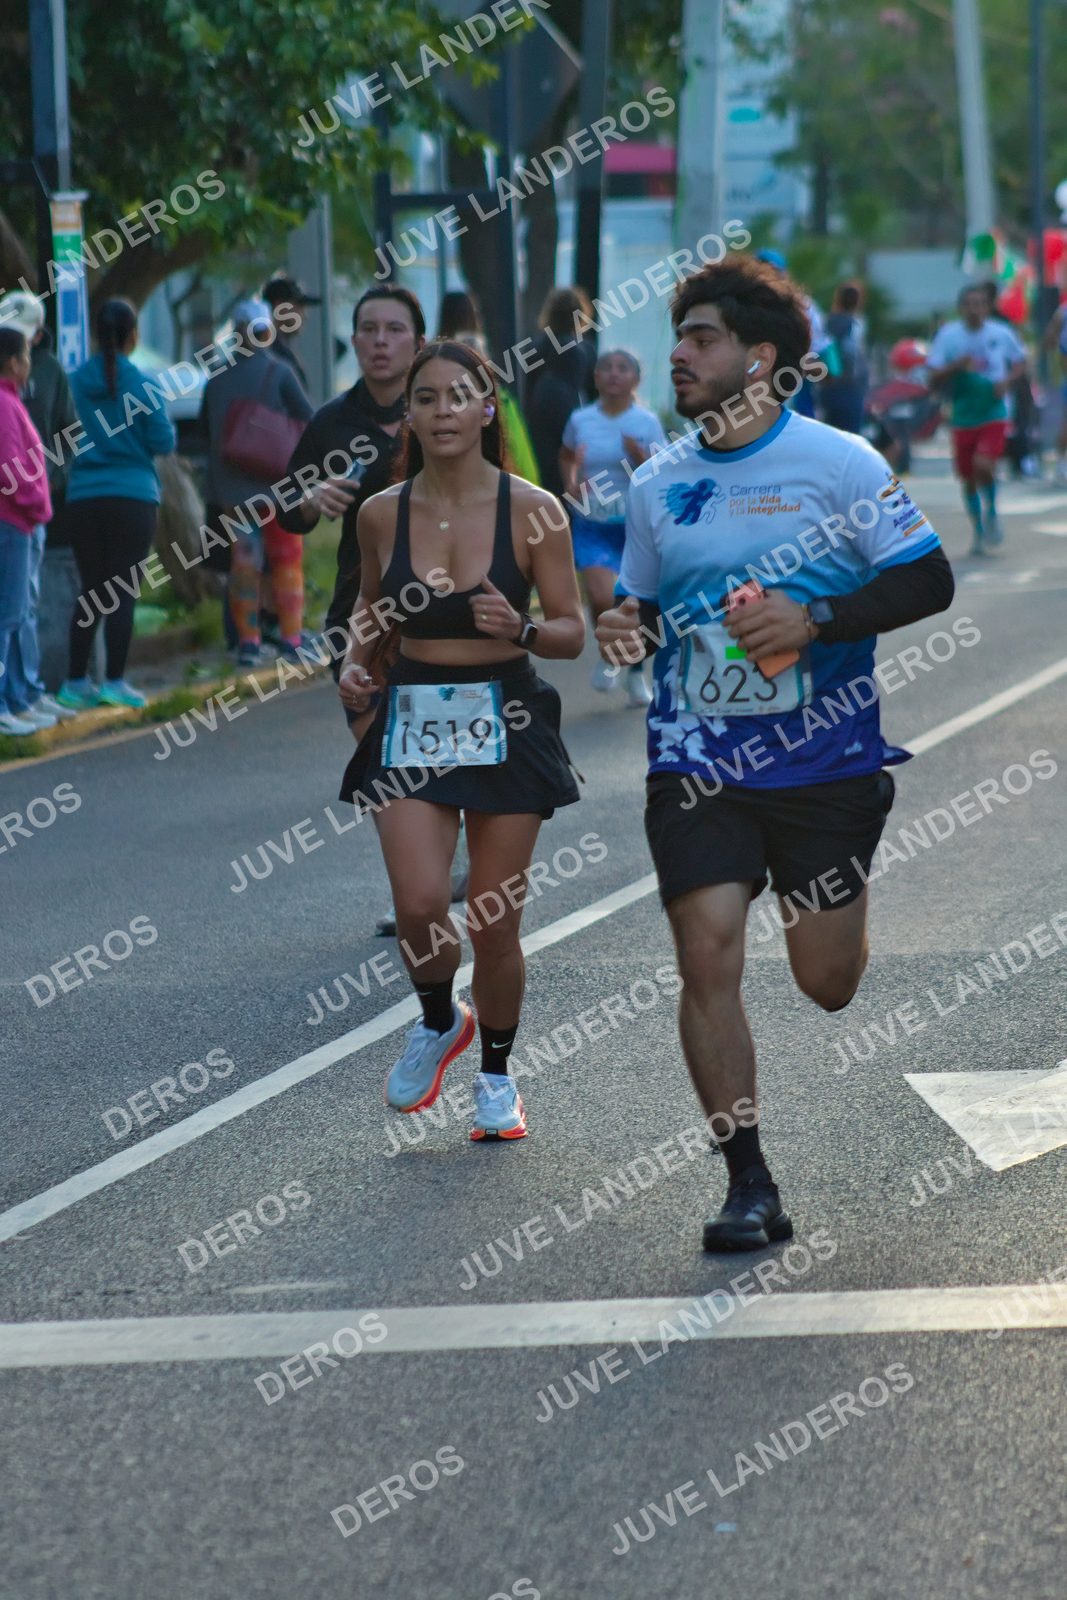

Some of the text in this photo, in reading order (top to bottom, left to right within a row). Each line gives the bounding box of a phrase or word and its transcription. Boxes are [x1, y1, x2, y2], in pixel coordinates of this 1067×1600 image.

[729, 484, 782, 497] Carrera
[758, 495, 782, 505] Vida
[401, 717, 493, 755] 1519
